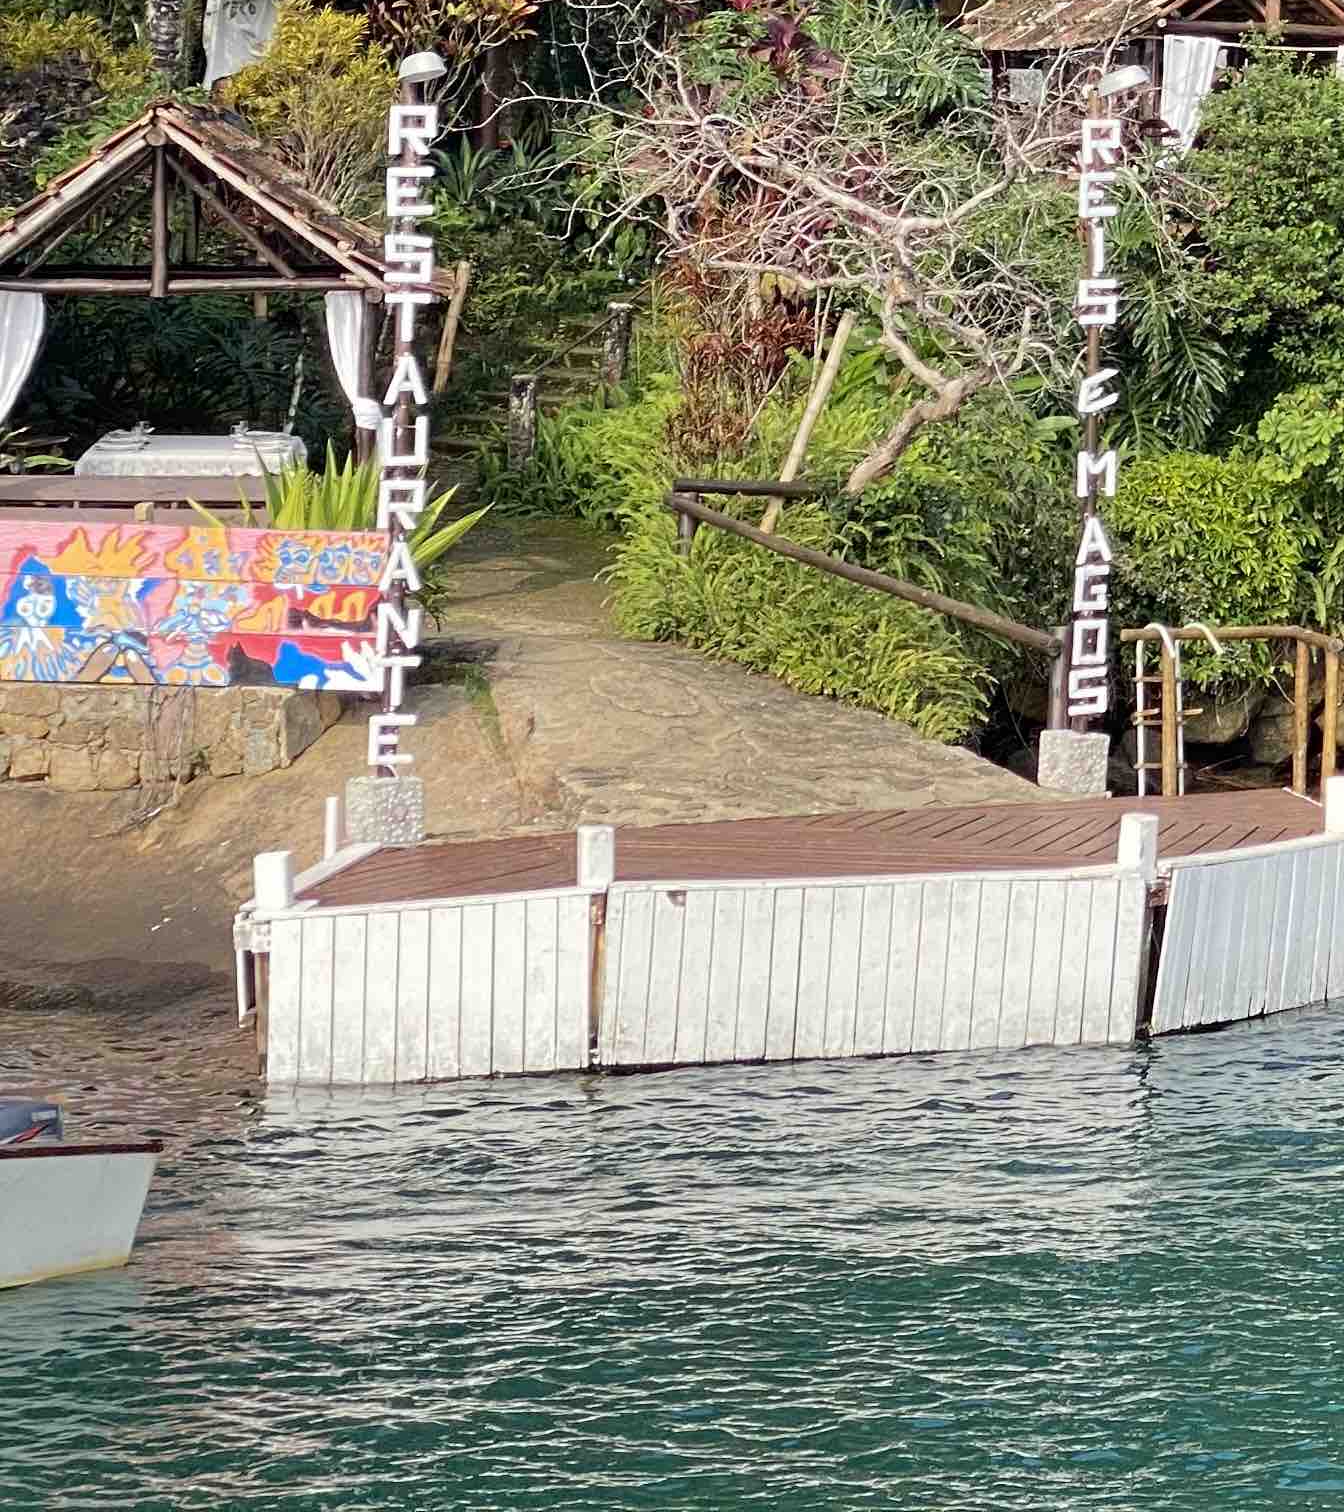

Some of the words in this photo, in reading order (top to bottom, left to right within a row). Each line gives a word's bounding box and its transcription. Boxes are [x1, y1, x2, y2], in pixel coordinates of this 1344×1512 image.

[1077, 119, 1121, 326] REIS
[368, 104, 439, 767] RESTAURANTE
[1067, 449, 1116, 717] MAGOS
